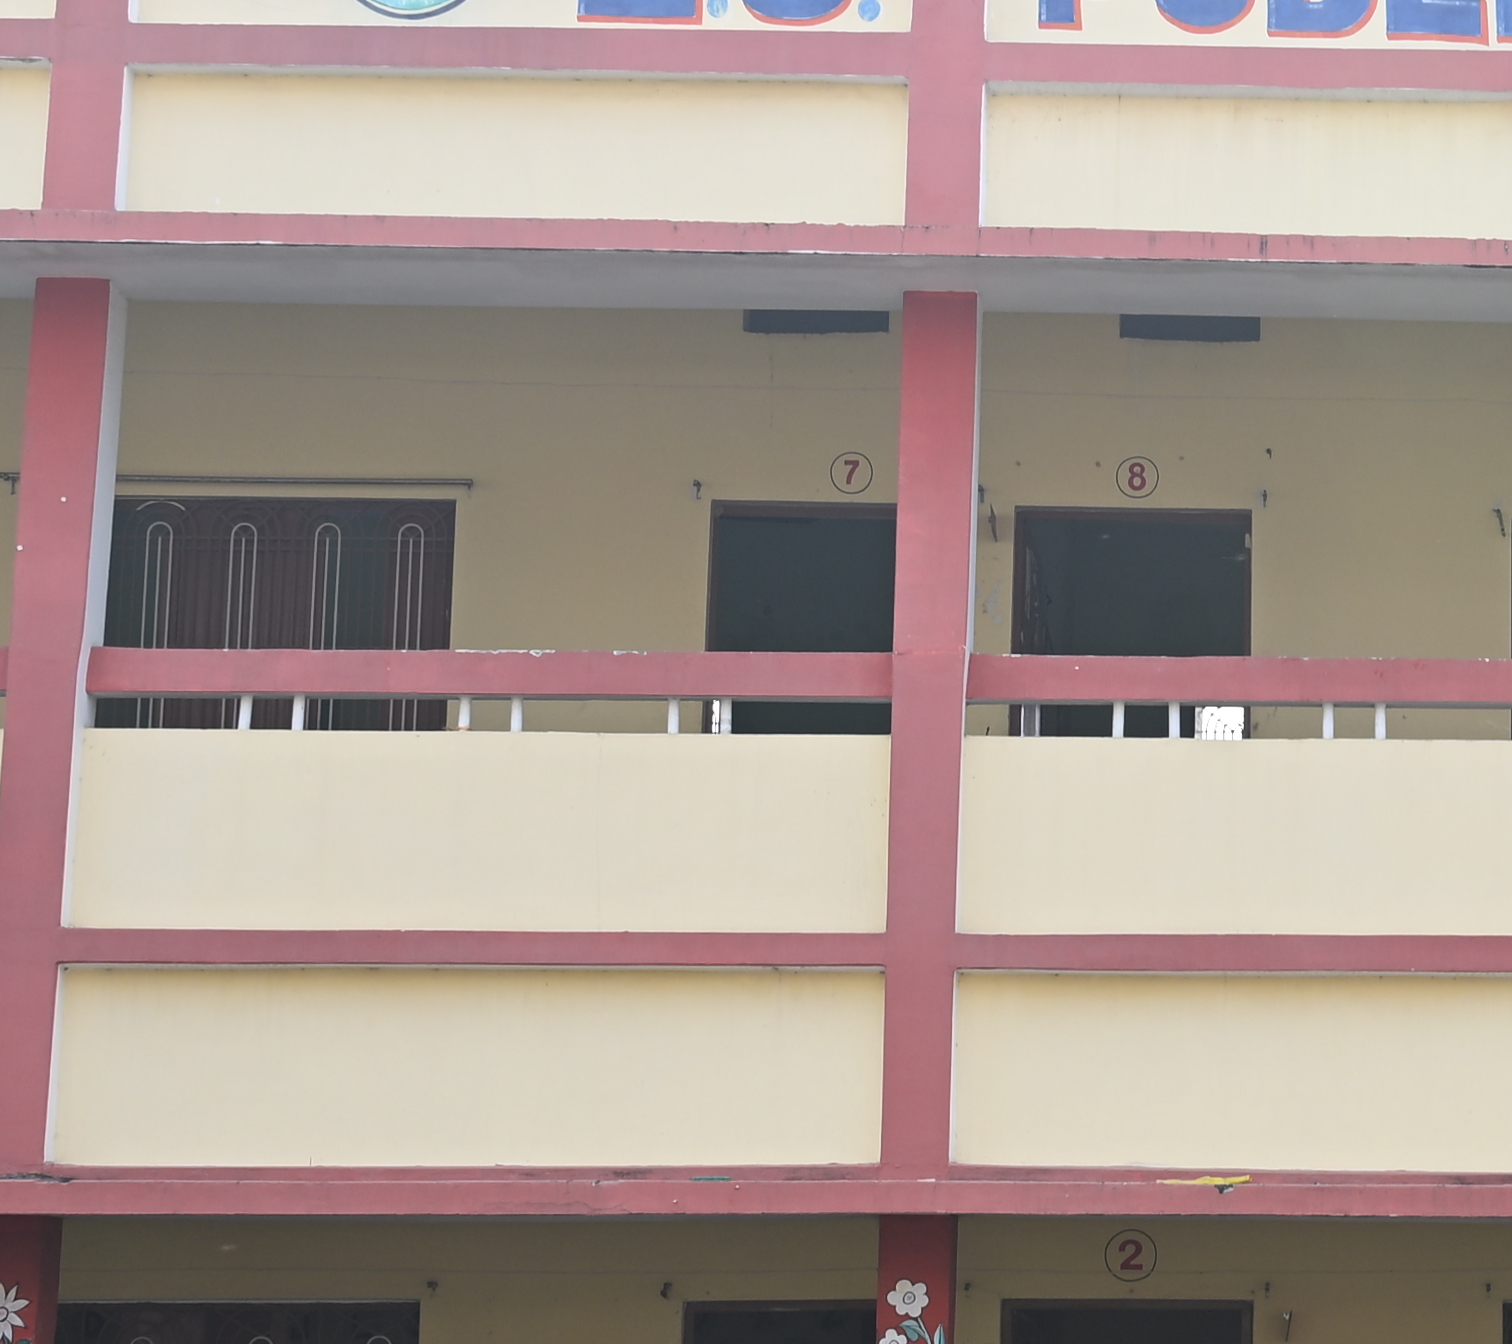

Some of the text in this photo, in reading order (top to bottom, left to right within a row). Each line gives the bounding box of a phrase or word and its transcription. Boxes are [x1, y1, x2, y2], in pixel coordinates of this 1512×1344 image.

[843, 460, 860, 486] 7
[1127, 461, 1147, 491] 8
[1117, 1239, 1144, 1271] 2
